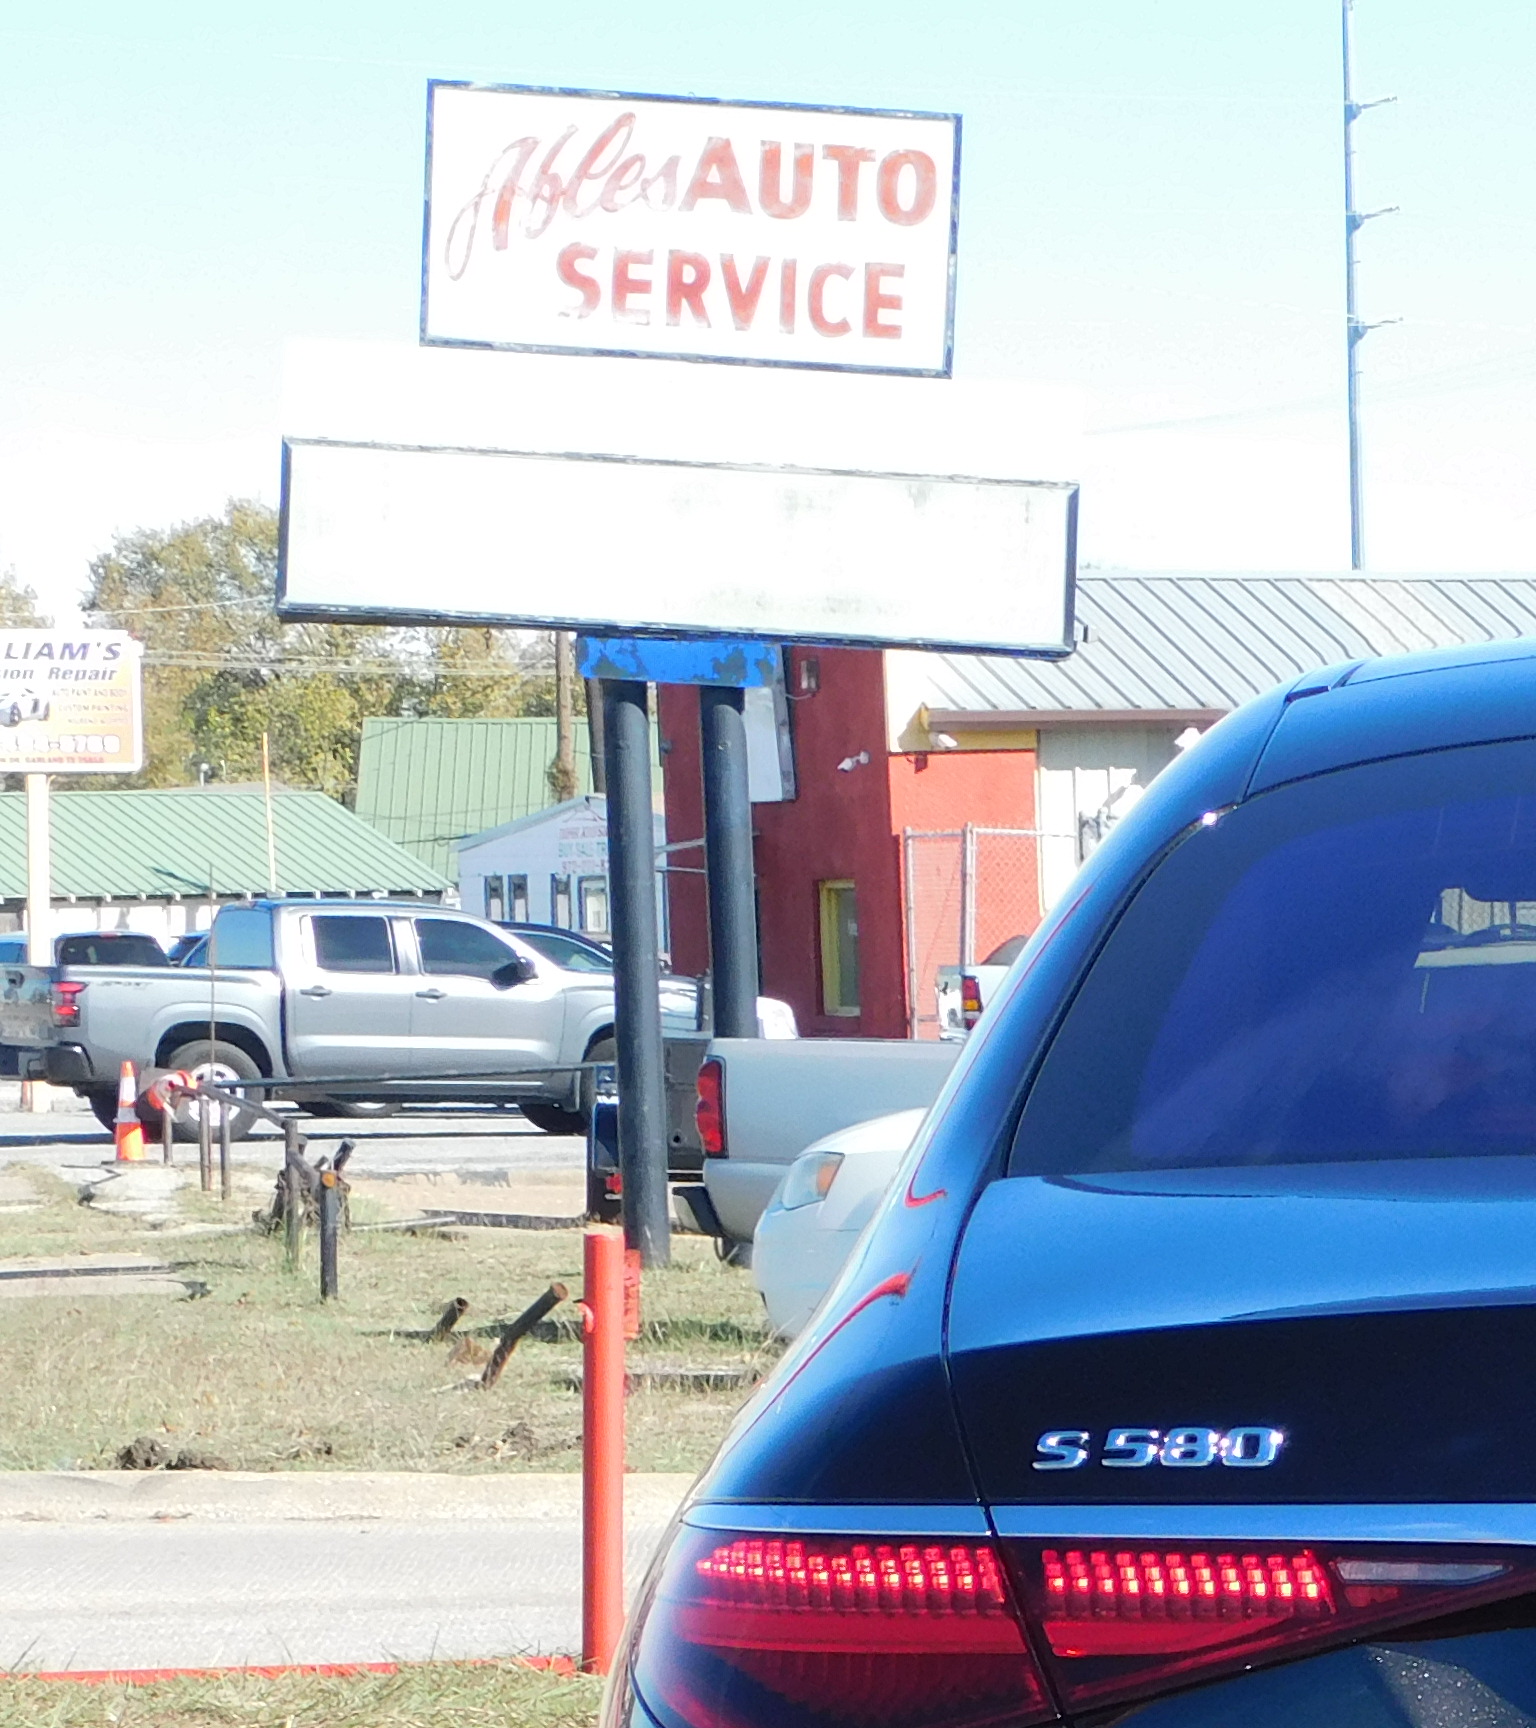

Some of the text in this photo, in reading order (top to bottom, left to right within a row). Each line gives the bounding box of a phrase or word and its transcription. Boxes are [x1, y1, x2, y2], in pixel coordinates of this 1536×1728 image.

[679, 136, 938, 228] AUTO
[555, 241, 905, 340] SERVICE
[0, 667, 118, 682] ion Repair
[1032, 1427, 1284, 1469] S 580
